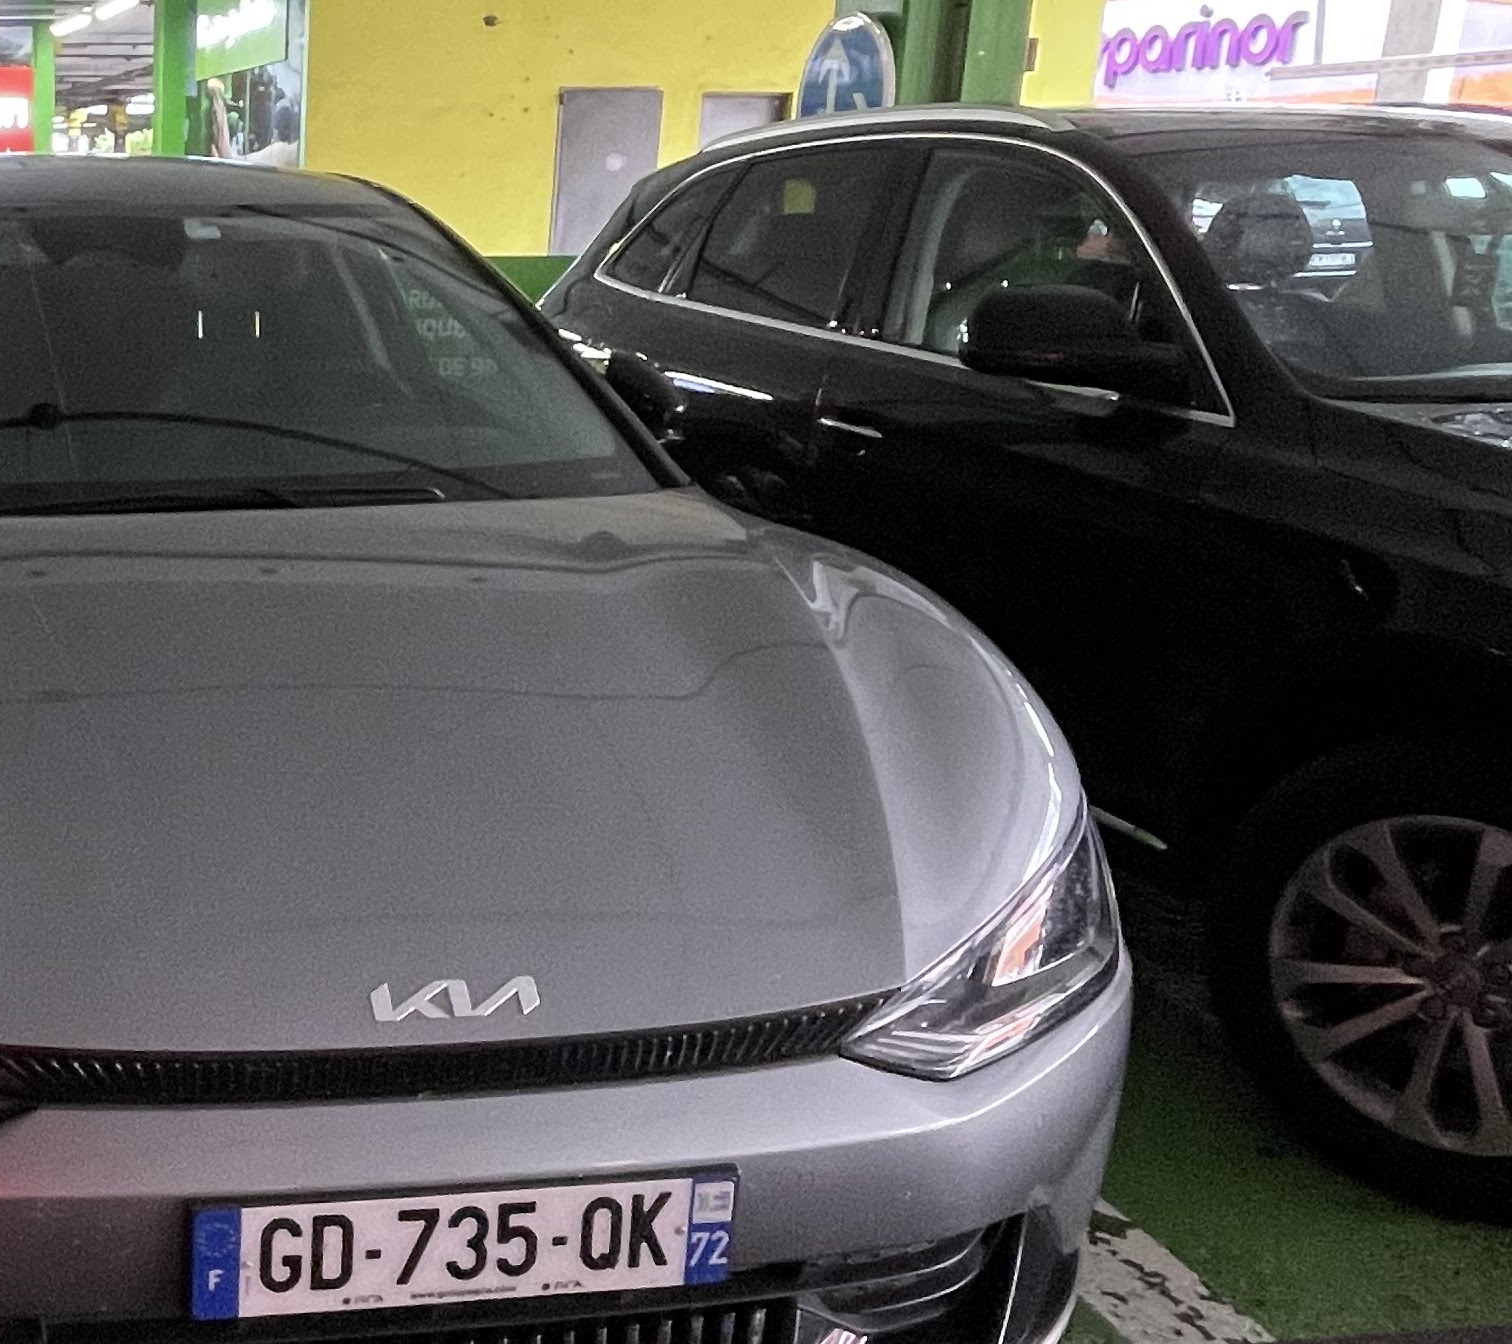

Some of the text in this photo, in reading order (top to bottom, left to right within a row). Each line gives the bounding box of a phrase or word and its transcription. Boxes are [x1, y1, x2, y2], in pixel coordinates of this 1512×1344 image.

[1099, 4, 1310, 89] parinor
[370, 975, 540, 1022] KIA
[207, 1269, 224, 1291] F
[259, 1191, 672, 1293] GD-735-QK
[689, 1230, 730, 1267] 72
